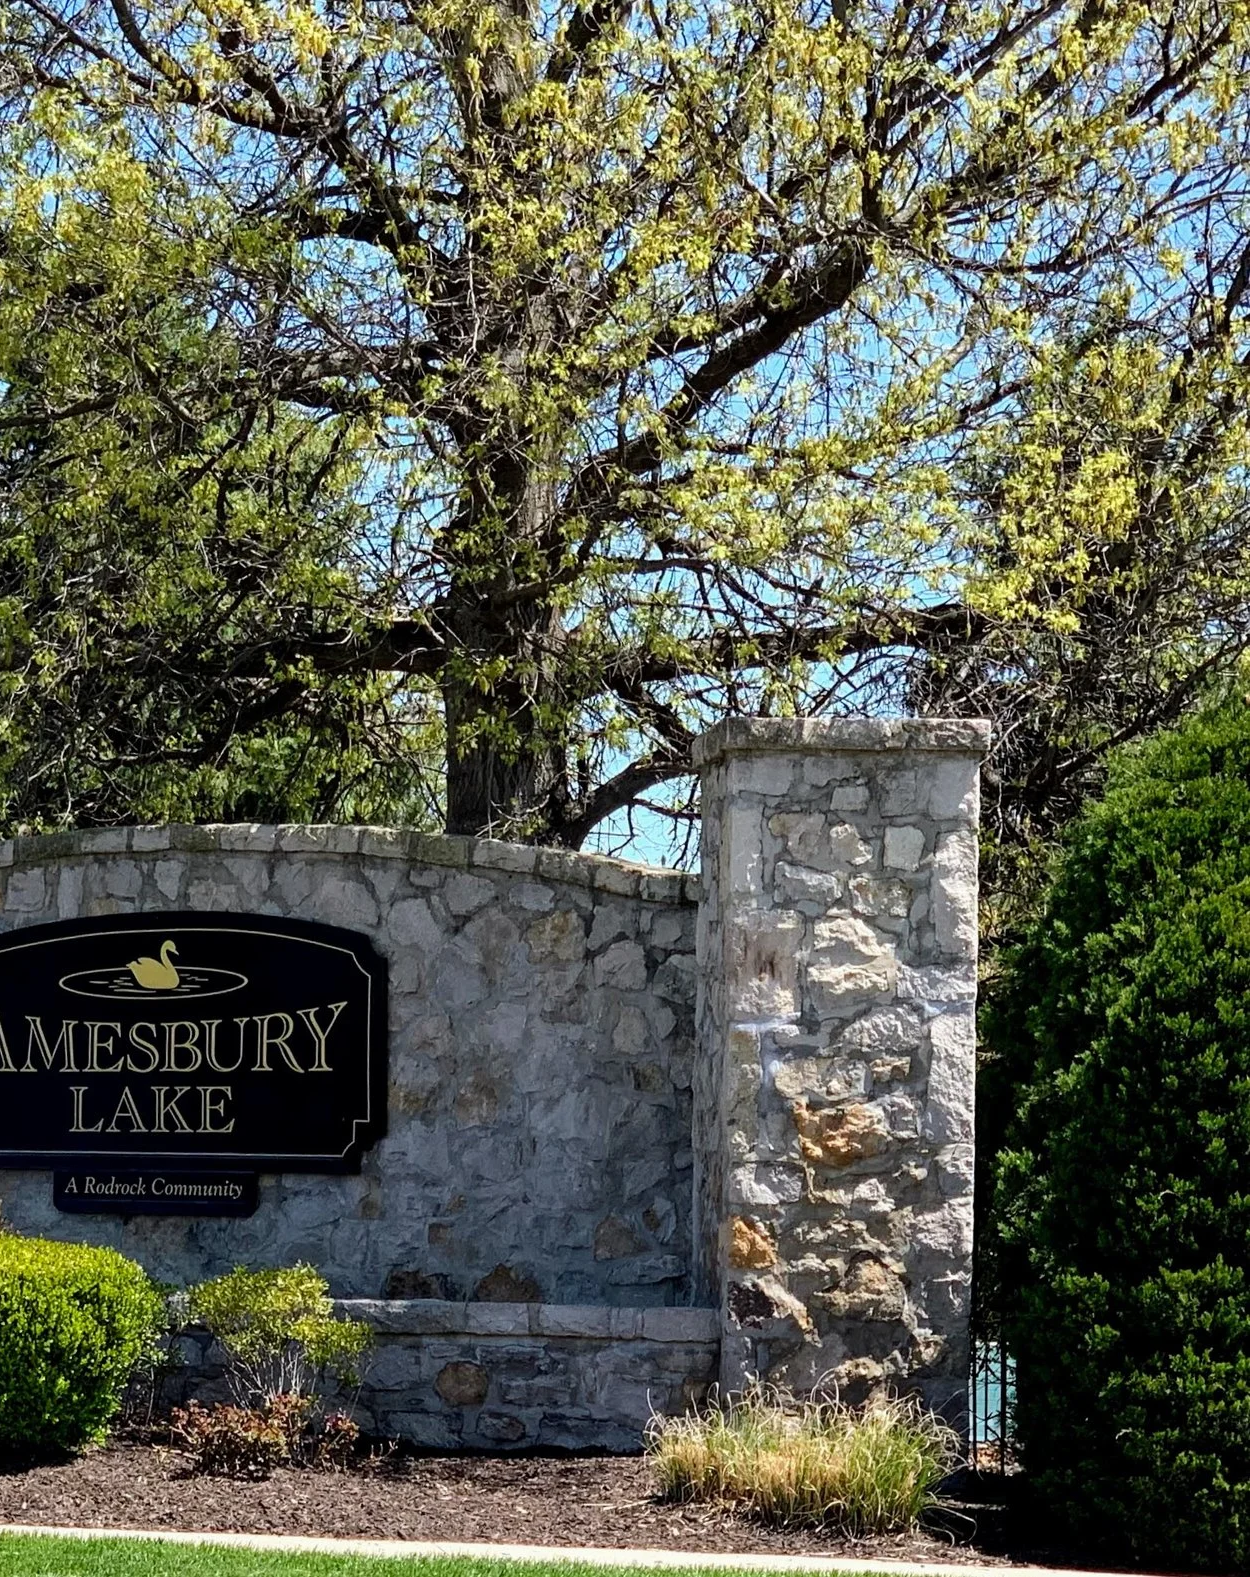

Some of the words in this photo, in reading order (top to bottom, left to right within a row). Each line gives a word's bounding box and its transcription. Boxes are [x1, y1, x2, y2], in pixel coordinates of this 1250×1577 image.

[68, 1085, 236, 1133] LAKE
[64, 1176, 78, 1194] A
[84, 1176, 147, 1195] Rodrock
[151, 1177, 243, 1200] Community
